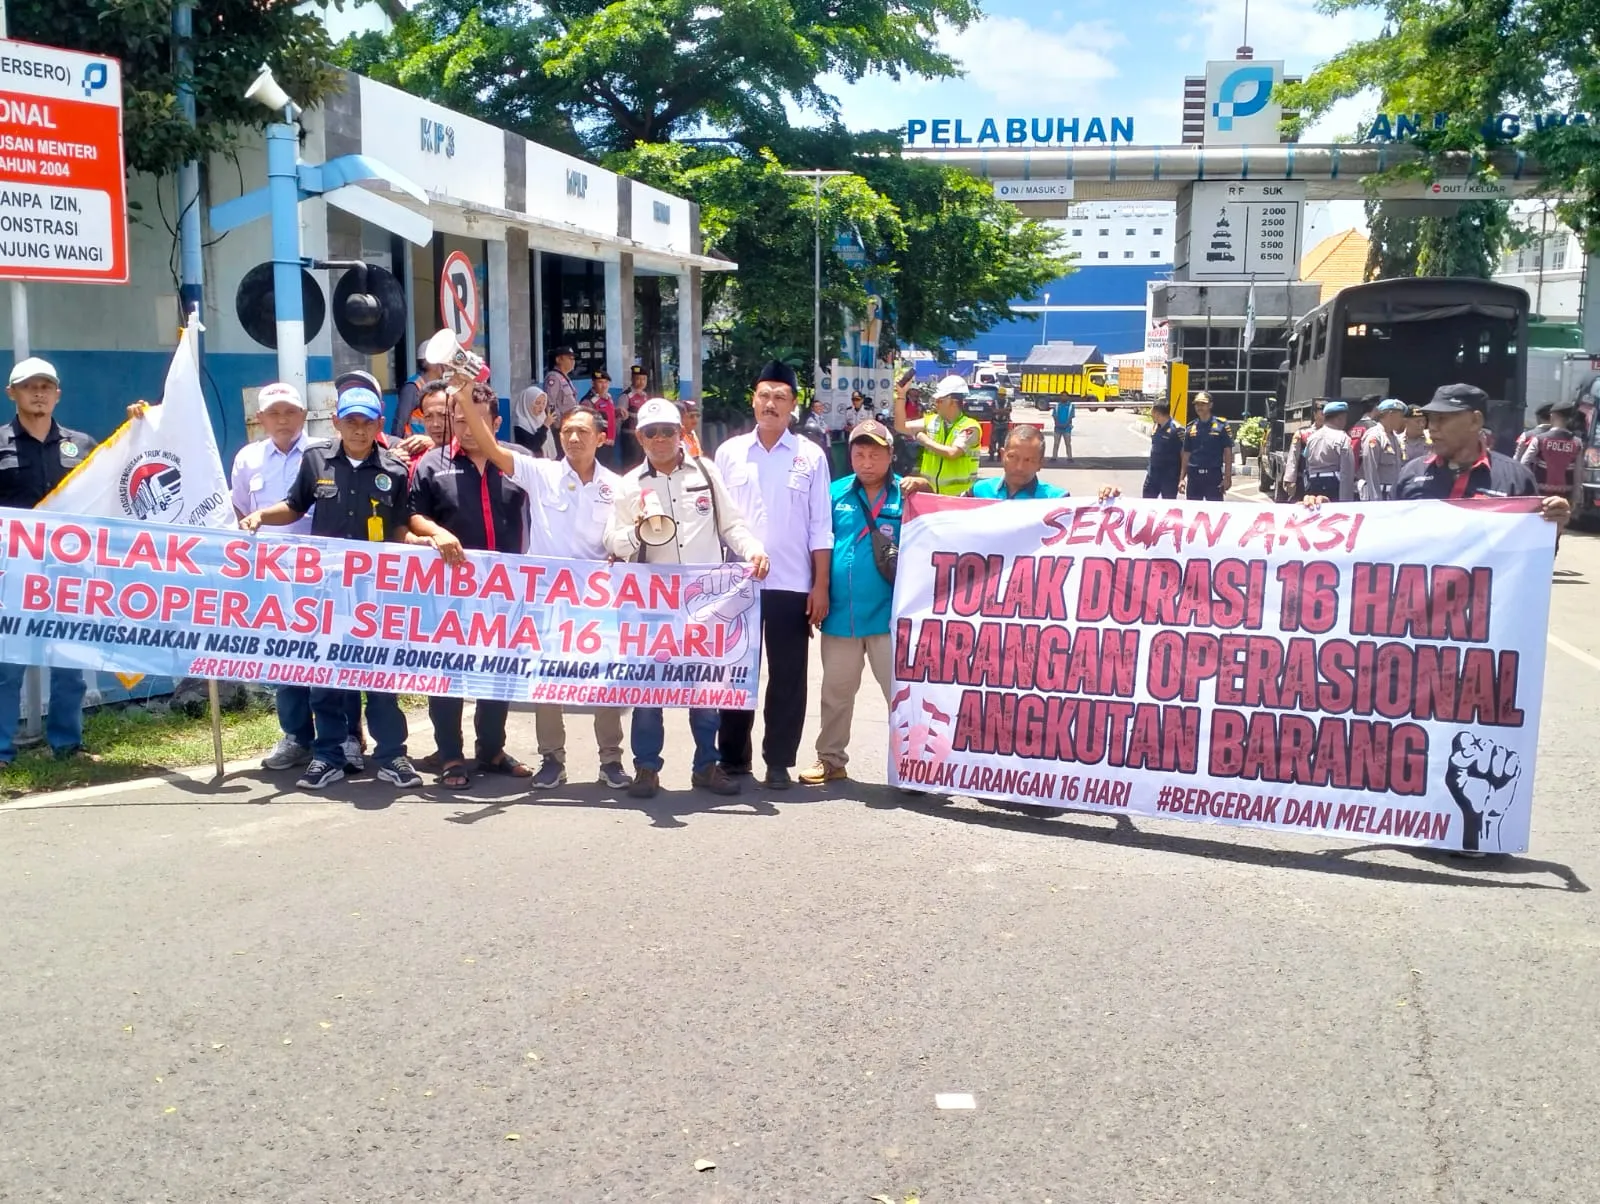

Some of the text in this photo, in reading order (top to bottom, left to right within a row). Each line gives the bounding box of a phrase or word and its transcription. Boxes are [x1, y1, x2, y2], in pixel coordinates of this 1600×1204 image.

[1, 57, 71, 86] ERSERO)
[908, 117, 1134, 143] PELABUHAN
[38, 139, 97, 159] MENTERI
[40, 161, 70, 177] 2004
[1010, 186, 1019, 194] IN
[1025, 186, 1057, 194] MASUK
[1443, 185, 1461, 193] OUT
[1469, 185, 1505, 193] KELUAR
[0, 191, 82, 215] ANPA IZIN,
[1, 216, 78, 236] ONSTRASI
[54, 244, 103, 261] WANGI
[1260, 241, 1283, 249] 5500
[1546, 441, 1573, 452] POLISI
[1041, 507, 1365, 554] SERUAN AKSI
[0, 518, 681, 610] NOLAK SKB PEMBATASAN
[932, 551, 1493, 643] TOLAK DURASI 16 HARI
[23, 574, 334, 635] BEROPERASI
[351, 603, 541, 650] SELAMA
[559, 619, 602, 654] 16
[619, 622, 725, 657] HARI
[25, 618, 201, 650] MENYENGSARAKAN
[205, 633, 259, 656] NASIB
[264, 638, 320, 663] SOPIR,
[327, 643, 389, 666] BURUH
[393, 648, 477, 672] BONGKAR
[481, 655, 531, 678] MUAT,
[540, 660, 599, 679] TENAGA
[606, 662, 656, 681] KERJA
[662, 662, 725, 682] HARIAN
[730, 666, 748, 683] !!!
[189, 657, 451, 694] #REVISI DURASI PEMBATASAN
[895, 618, 1525, 728] LARANGAN OPERASIONAL
[532, 683, 749, 707] #BERGERAKDANMELAWAN
[952, 690, 1430, 797] ANGKUTAN BARANG
[899, 758, 1132, 807] #TOLAK LARANGAN 16 HARI
[1157, 785, 1451, 840] #BERGERAK DAN MELAWAN
